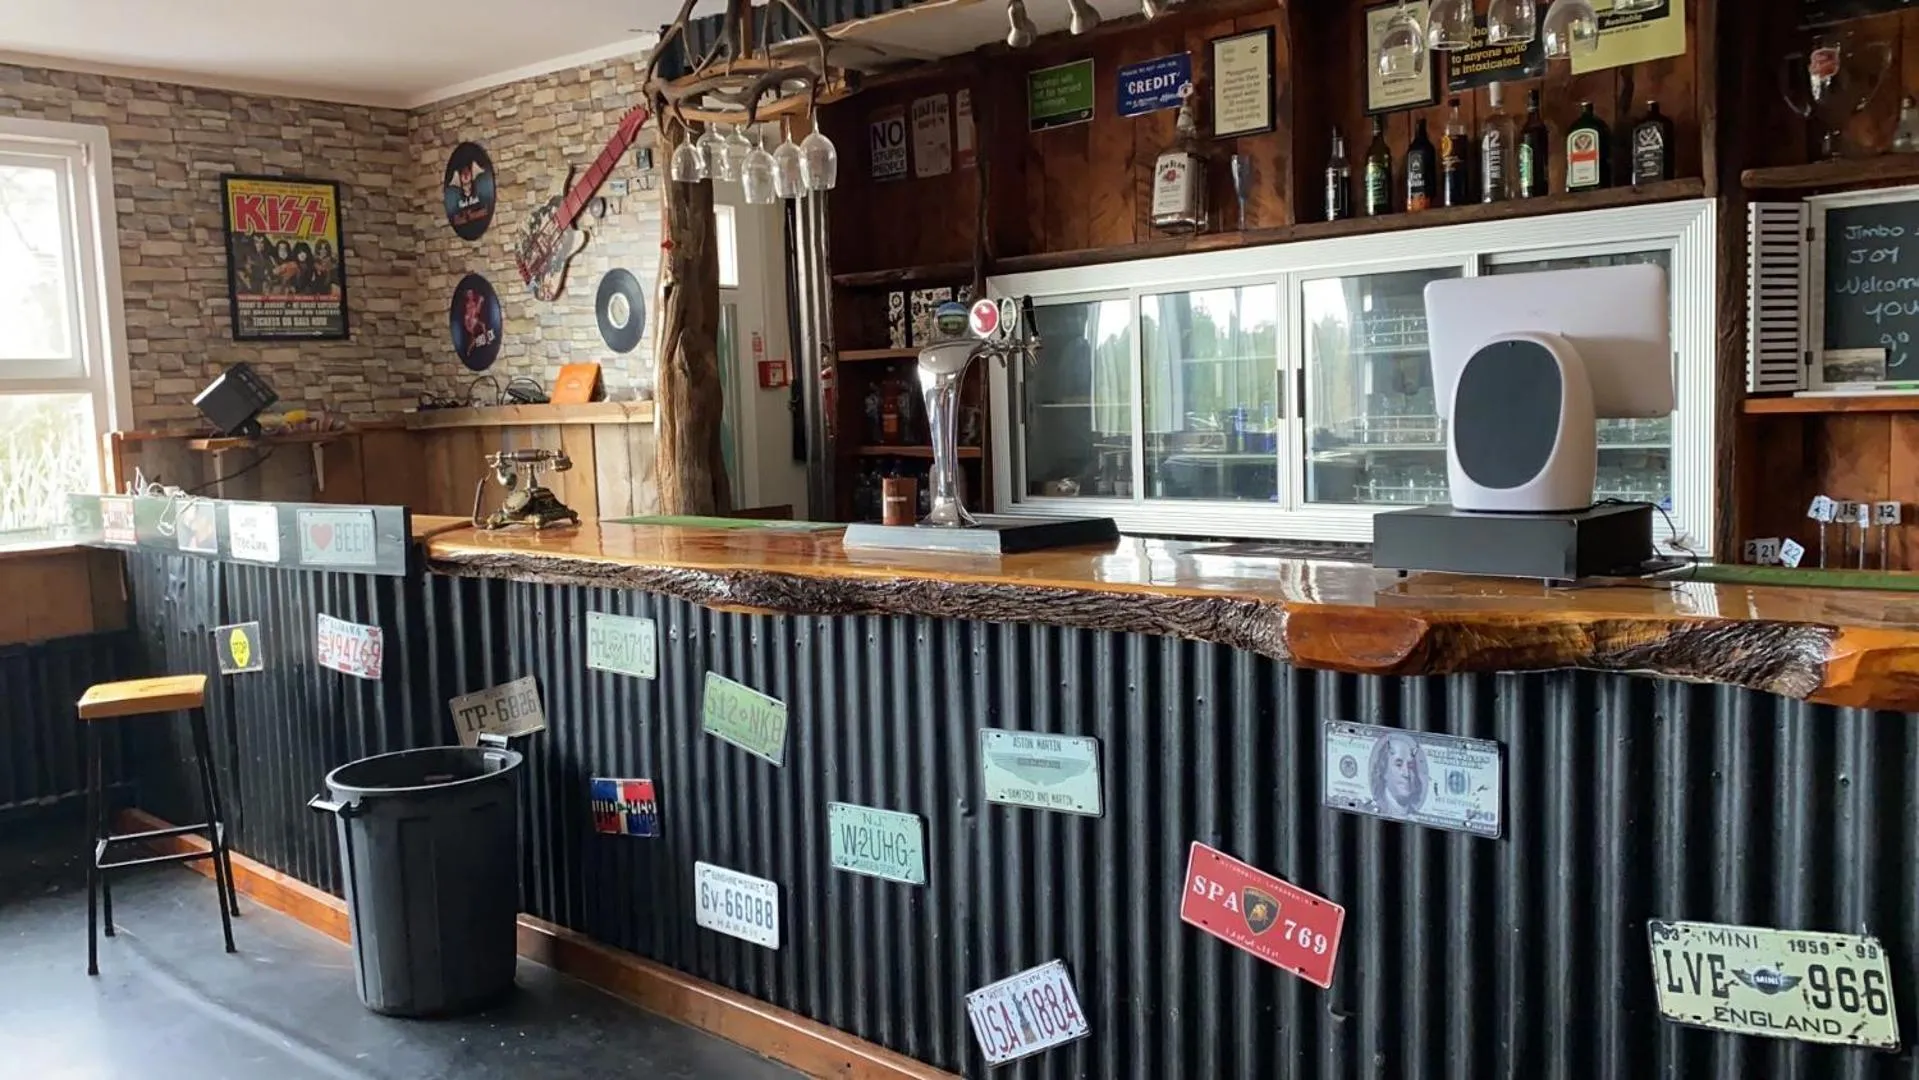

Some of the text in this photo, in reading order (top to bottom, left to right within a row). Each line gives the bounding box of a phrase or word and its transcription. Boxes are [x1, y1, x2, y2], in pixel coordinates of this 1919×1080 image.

[1452, 42, 1527, 64] to anyone who
[1452, 55, 1521, 76] is intoxicated
[872, 120, 903, 150] NO
[233, 194, 329, 236] KISS
[1845, 223, 1905, 240] Jimbo
[1843, 503, 1857, 515] 15
[1879, 504, 1895, 518] 12
[303, 523, 373, 552] I BEER
[1761, 544, 1776, 558] 21
[1784, 543, 1801, 559] 22
[1192, 874, 1239, 913] SPA
[1283, 920, 1328, 955] 769
[1707, 931, 1759, 949] MINI
[1663, 950, 1730, 998] LVE
[1808, 964, 1888, 1017] 966
[974, 979, 1080, 1056] USA 1884
[1713, 1006, 1842, 1036] ENGLAND
